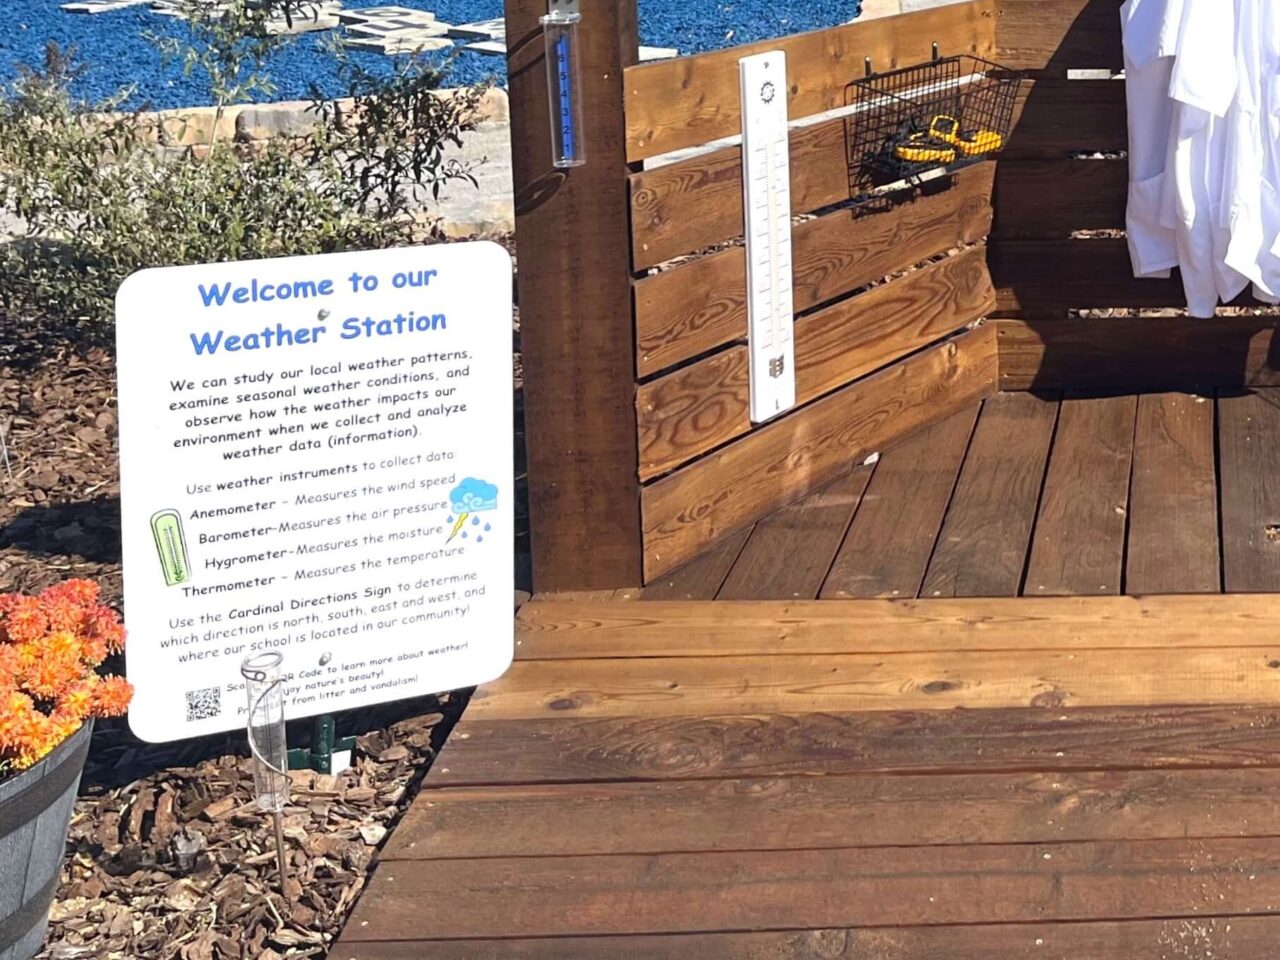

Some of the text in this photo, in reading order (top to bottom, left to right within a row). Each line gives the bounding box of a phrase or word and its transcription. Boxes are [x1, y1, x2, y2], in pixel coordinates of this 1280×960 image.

[197, 269, 437, 307] Welcome to our
[189, 310, 446, 355] Weather Station
[168, 364, 470, 411] examine seasonal weather conditions, and
[169, 349, 472, 392] We can study our local weather patterns,
[172, 402, 467, 448] environment when we collect and analyze
[184, 386, 456, 428] observe how the weather impacts our
[222, 443, 283, 460] weather
[288, 439, 321, 452] data
[185, 483, 211, 495] Use
[215, 474, 273, 491] weather
[279, 463, 358, 482] instruments
[362, 461, 376, 470] to
[379, 454, 421, 468] collect
[188, 473, 455, 520] Anemometer Measures the wind speed
[345, 511, 366, 521] the
[370, 509, 388, 519] air
[392, 500, 447, 518] pressure
[362, 534, 383, 544] the
[388, 526, 442, 540] moisture
[180, 547, 464, 597] Thermometer Measures the temperature
[160, 632, 199, 648] which
[202, 623, 264, 641] direction
[268, 620, 278, 630] is
[282, 612, 319, 627] north,
[327, 606, 365, 621] south,
[370, 600, 398, 613] east
[401, 596, 424, 608] and
[464, 585, 485, 597] and
[168, 572, 476, 629] Use the Cardinal Directions Sign to determine
[178, 648, 219, 663] where
[223, 644, 245, 655] our
[250, 634, 291, 651] school
[295, 633, 306, 642] is
[310, 623, 358, 640] located
[362, 622, 373, 630] in
[376, 618, 397, 629] our
[226, 682, 245, 692] Sca
